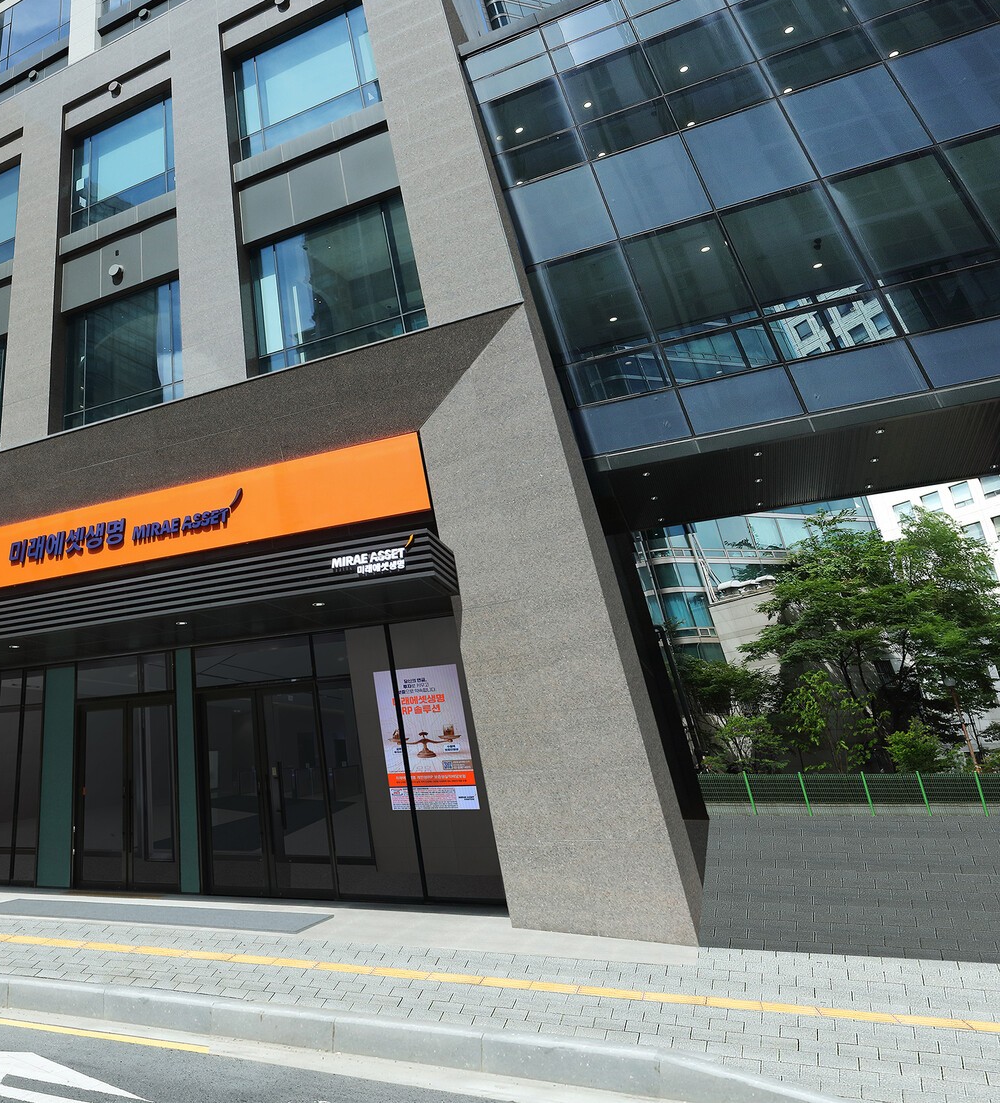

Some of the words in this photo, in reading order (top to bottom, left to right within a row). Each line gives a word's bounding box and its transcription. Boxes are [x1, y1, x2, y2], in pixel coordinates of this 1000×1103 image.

[132, 518, 179, 543] MIRAE
[181, 507, 231, 531] ASSET
[9, 518, 125, 563] 미래에셋생명
[331, 553, 368, 569] MIRAE
[369, 547, 405, 563] ASSET
[356, 559, 405, 574] 미래에셋생명
[413, 703, 441, 715] 솔루션
